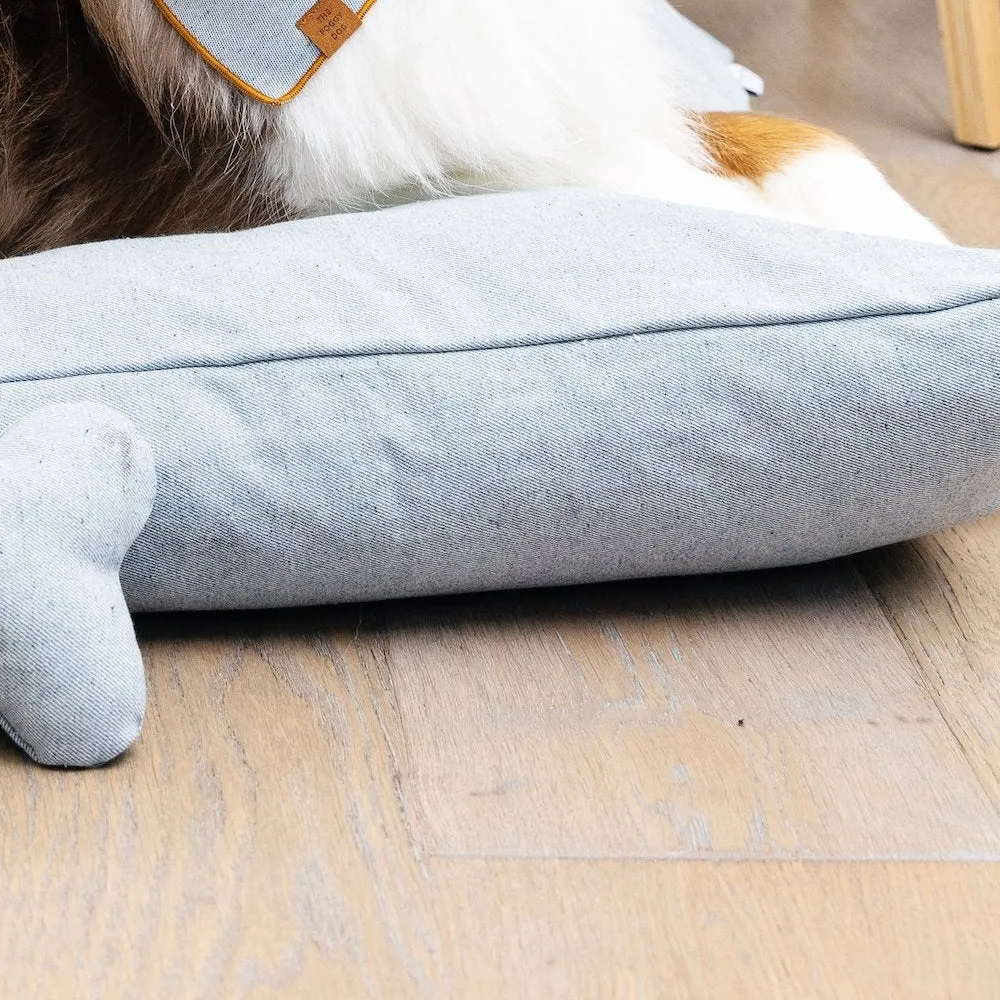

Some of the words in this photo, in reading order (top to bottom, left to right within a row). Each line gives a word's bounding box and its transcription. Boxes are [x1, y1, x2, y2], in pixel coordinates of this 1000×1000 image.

[317, 8, 332, 23] THE
[319, 11, 343, 35] FOGGY
[331, 24, 347, 40] DOG
